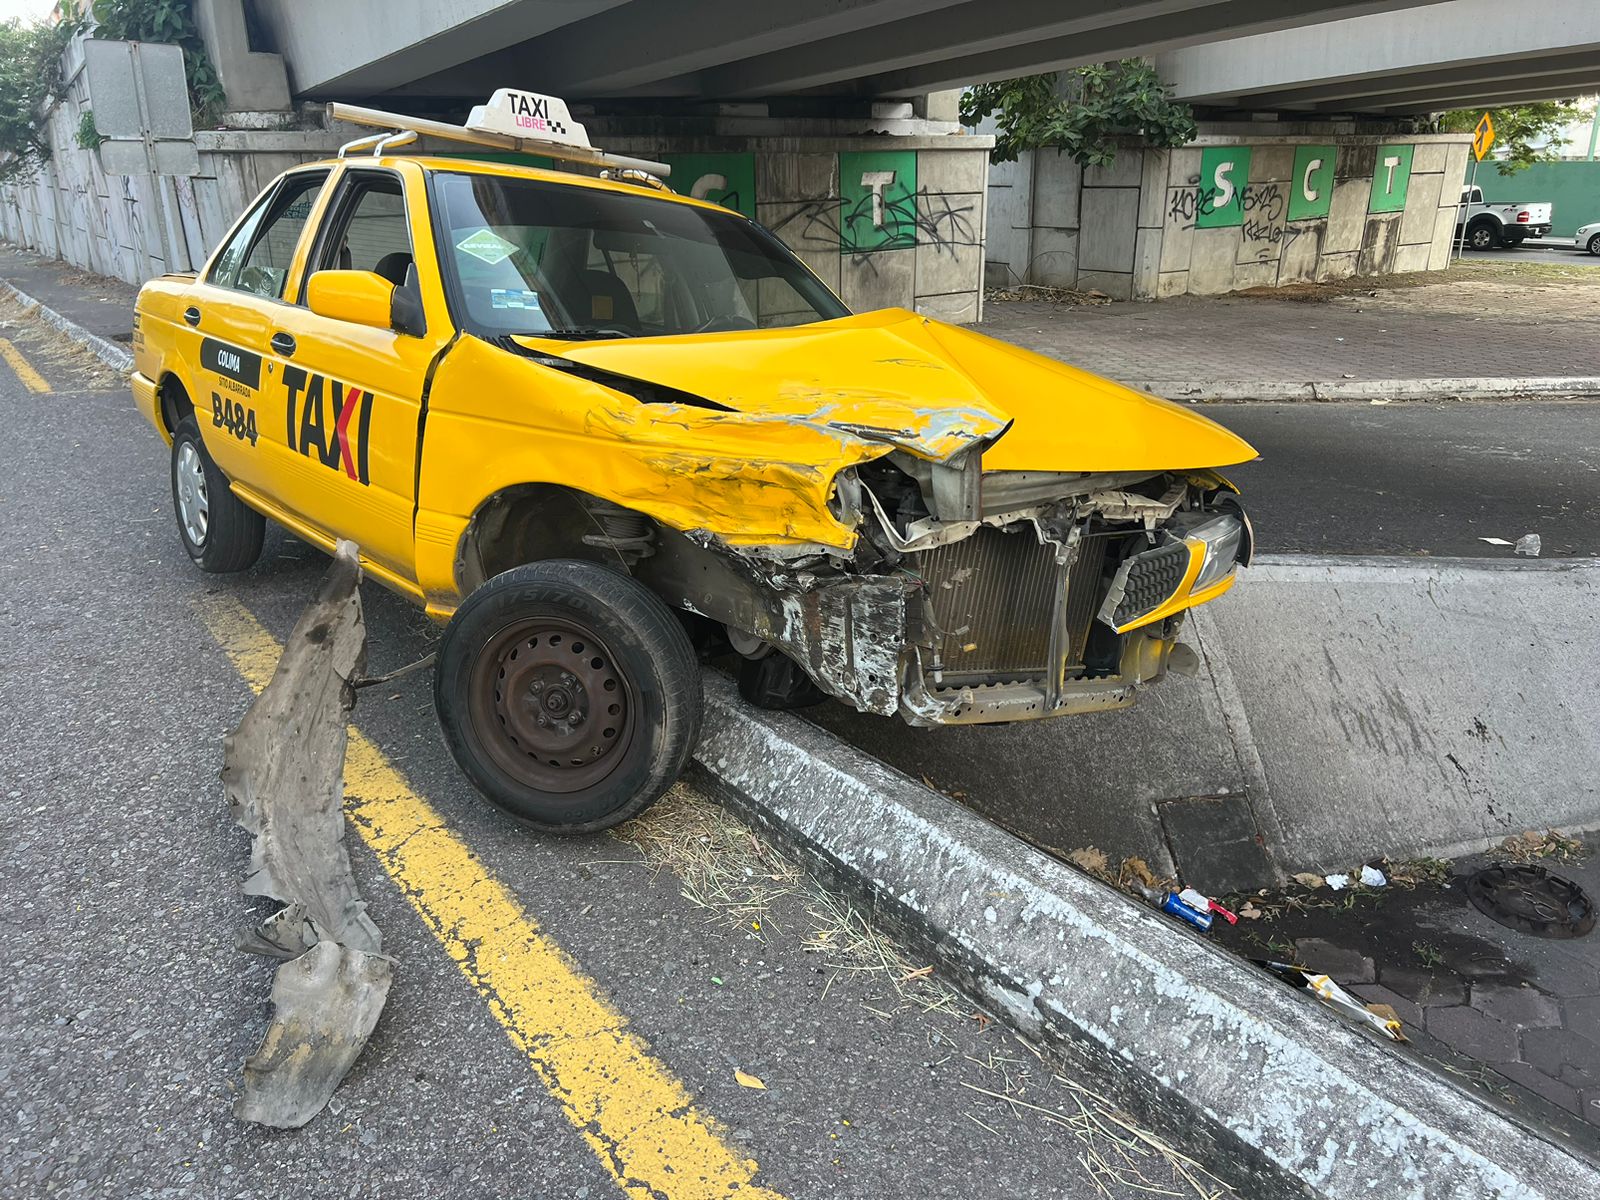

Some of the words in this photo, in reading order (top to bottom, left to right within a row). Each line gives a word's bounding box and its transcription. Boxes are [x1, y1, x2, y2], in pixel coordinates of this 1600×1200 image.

[507, 93, 549, 119] TAXI
[515, 115, 546, 131] LIBRE
[860, 170, 897, 227] T
[218, 349, 240, 373] COLIMA
[228, 380, 251, 398] ALBARRADA
[212, 391, 258, 447] B484
[282, 364, 375, 487] TAXI
